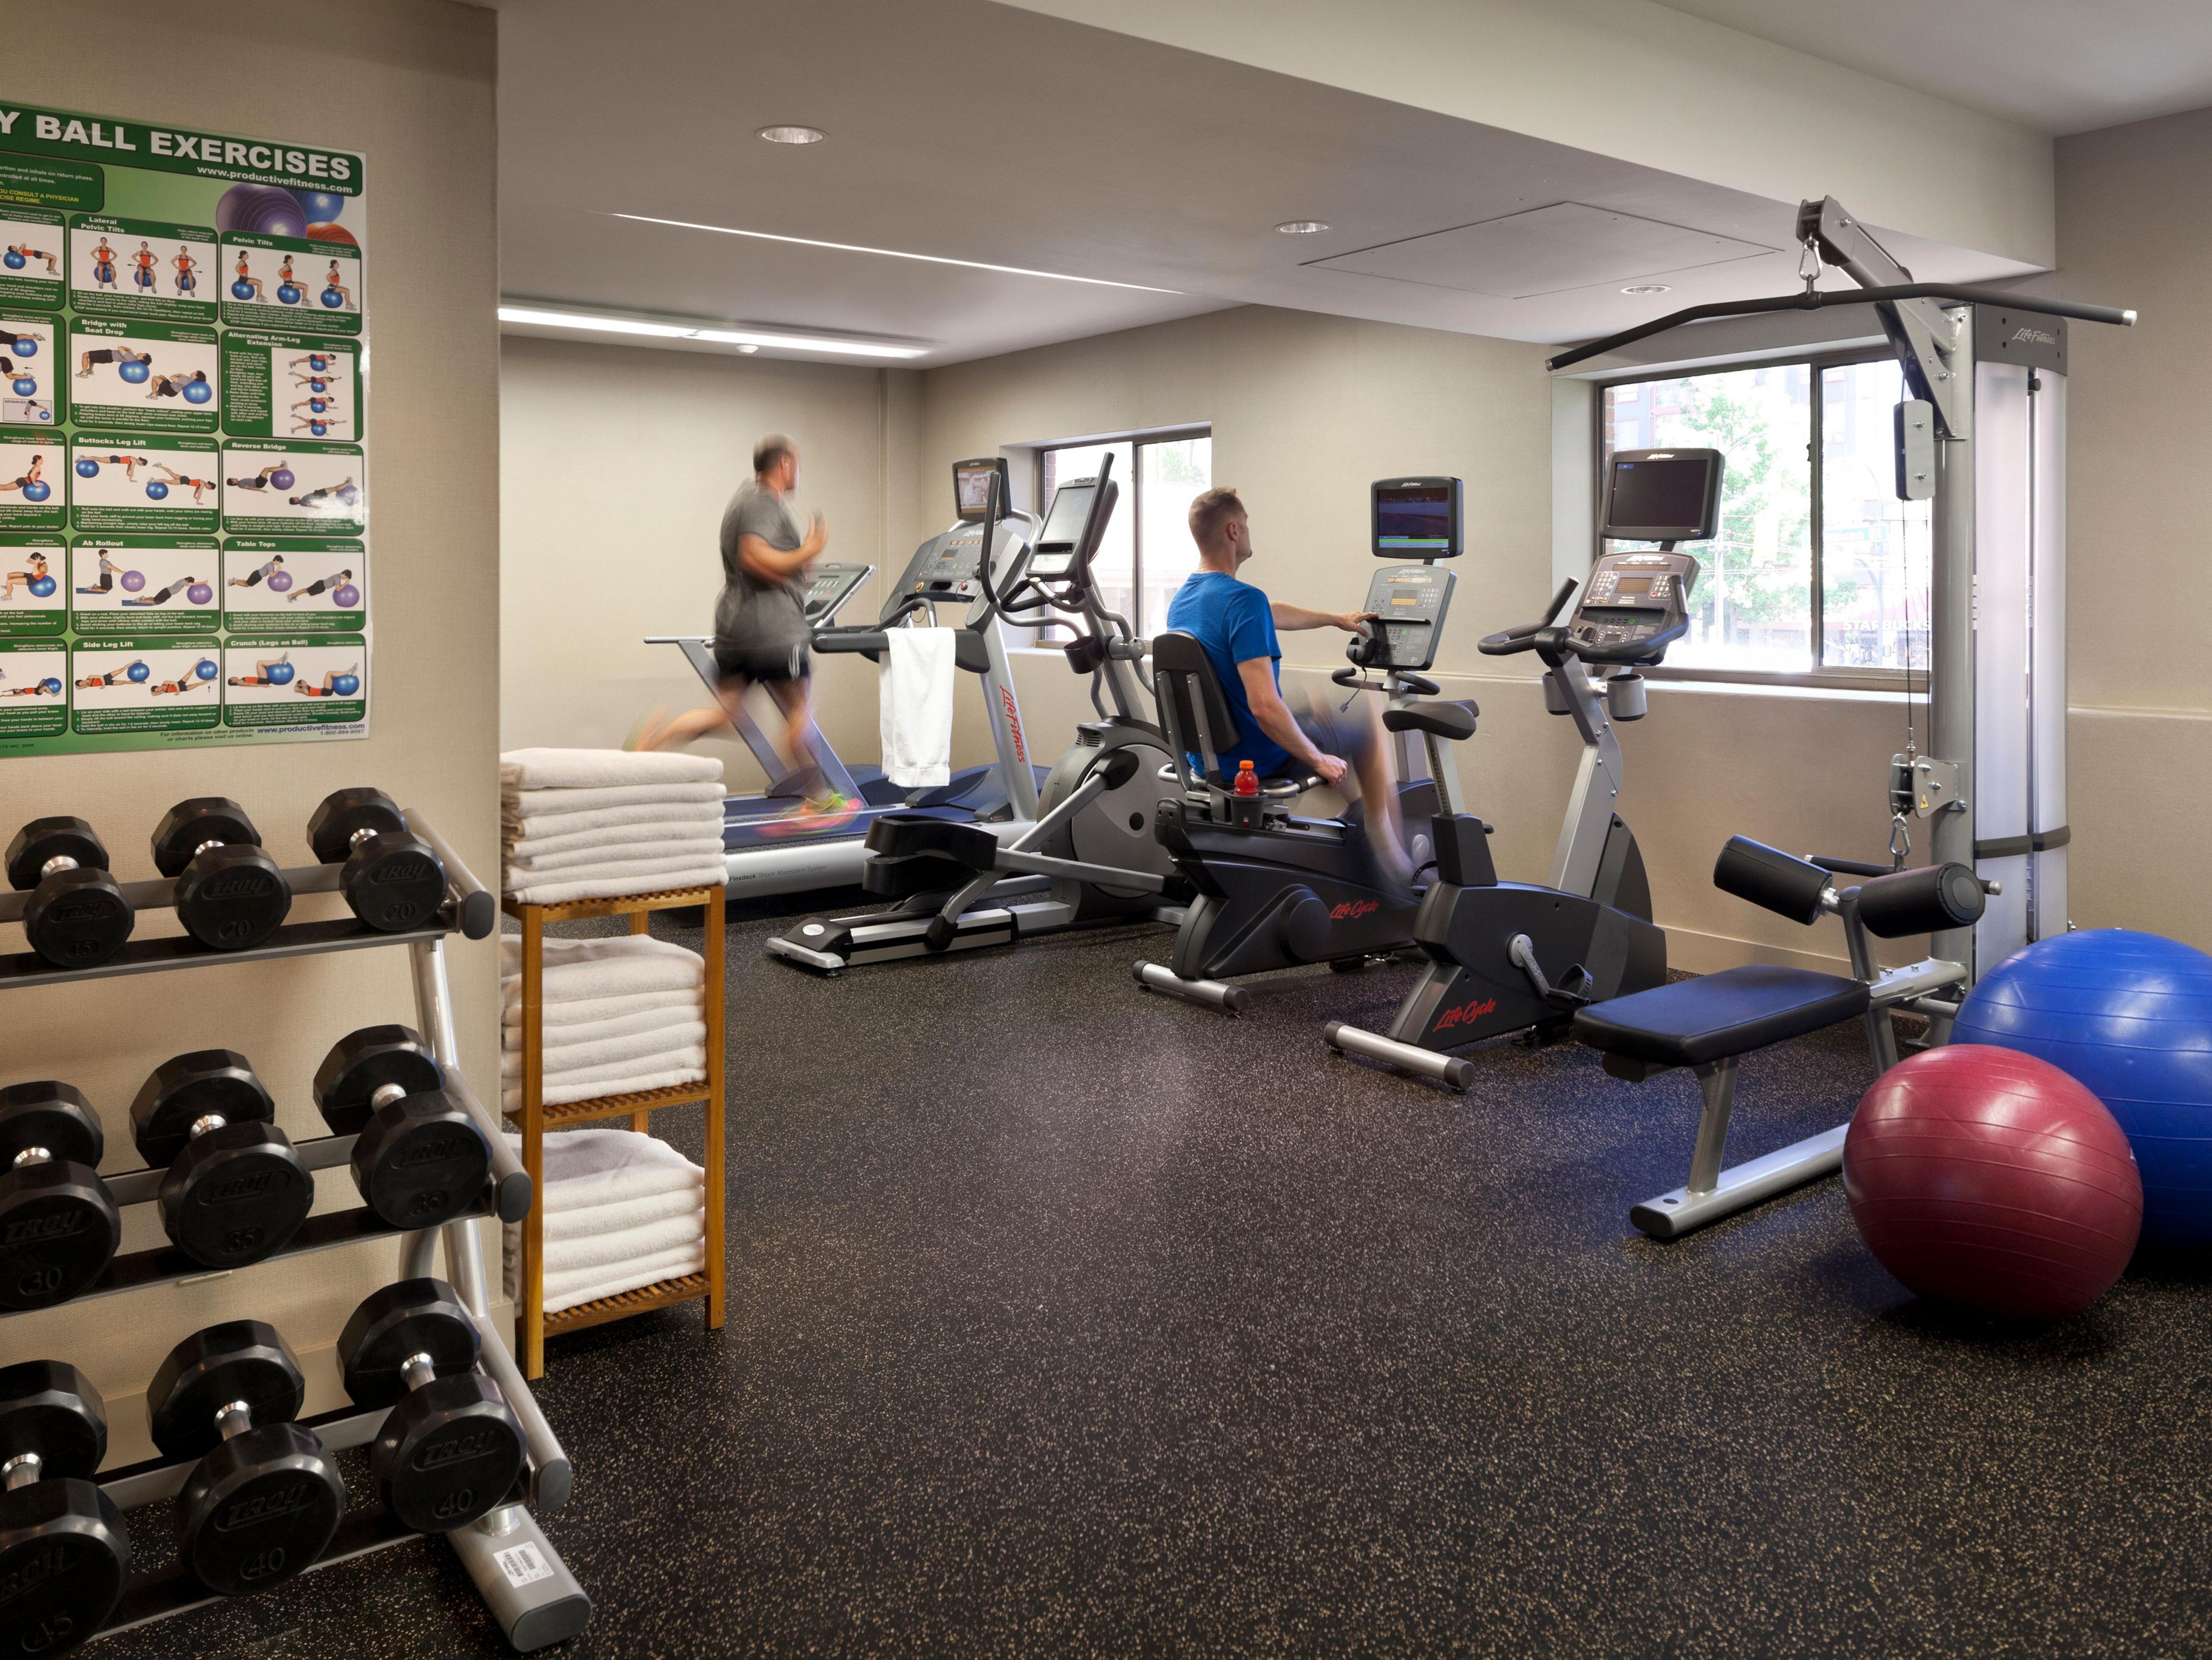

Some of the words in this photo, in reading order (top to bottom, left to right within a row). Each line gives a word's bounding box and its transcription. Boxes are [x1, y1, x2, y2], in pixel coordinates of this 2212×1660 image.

[36, 115, 136, 150] BALL
[150, 131, 350, 180] EXERCISES
[197, 166, 353, 193] www.productivefitness.com
[46, 194, 79, 202] PHYSICIAN
[89, 216, 117, 225] Lateral
[82, 320, 107, 328] Bridge
[228, 332, 268, 341] Alternating
[270, 335, 300, 344] Arm-Leg
[247, 339, 283, 347] Extension
[1845, 620, 1929, 631] STARBUCKS
[292, 638, 308, 647] Ball)
[257, 724, 365, 733] www.productivefitness.com
[376, 865, 424, 881] TROY
[212, 878, 265, 896] TROY
[388, 903, 412, 920] 20
[226, 920, 250, 937] 20
[74, 942, 91, 955] 15
[1433, 1006, 1463, 1033] Life
[1463, 997, 1496, 1024] Cycle
[6, 1210, 84, 1241] TROY
[26, 1268, 62, 1291] 30
[425, 1430, 494, 1466] TROY
[228, 1482, 309, 1525] TROY
[440, 1489, 473, 1514] 40
[249, 1547, 285, 1574] 40
